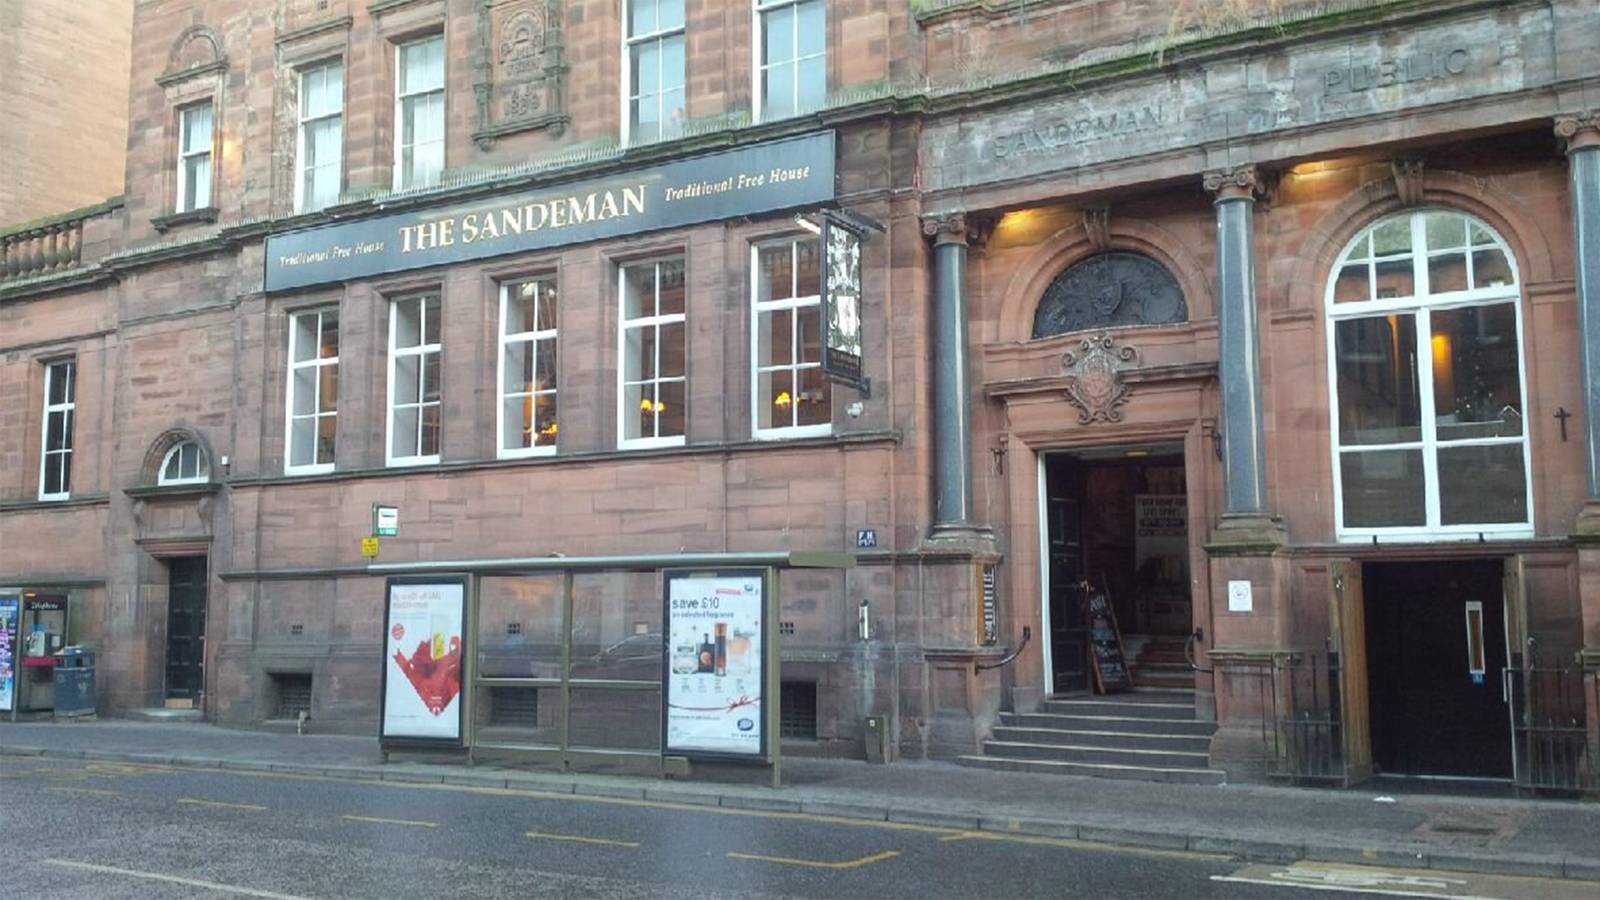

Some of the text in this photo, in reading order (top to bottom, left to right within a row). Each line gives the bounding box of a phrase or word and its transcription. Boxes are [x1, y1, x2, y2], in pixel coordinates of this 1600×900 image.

[664, 165, 810, 202] Traditional Free House
[399, 183, 648, 254] THE SANDEMAN
[279, 241, 385, 268] Traditional Free House
[672, 596, 720, 609] save £10
